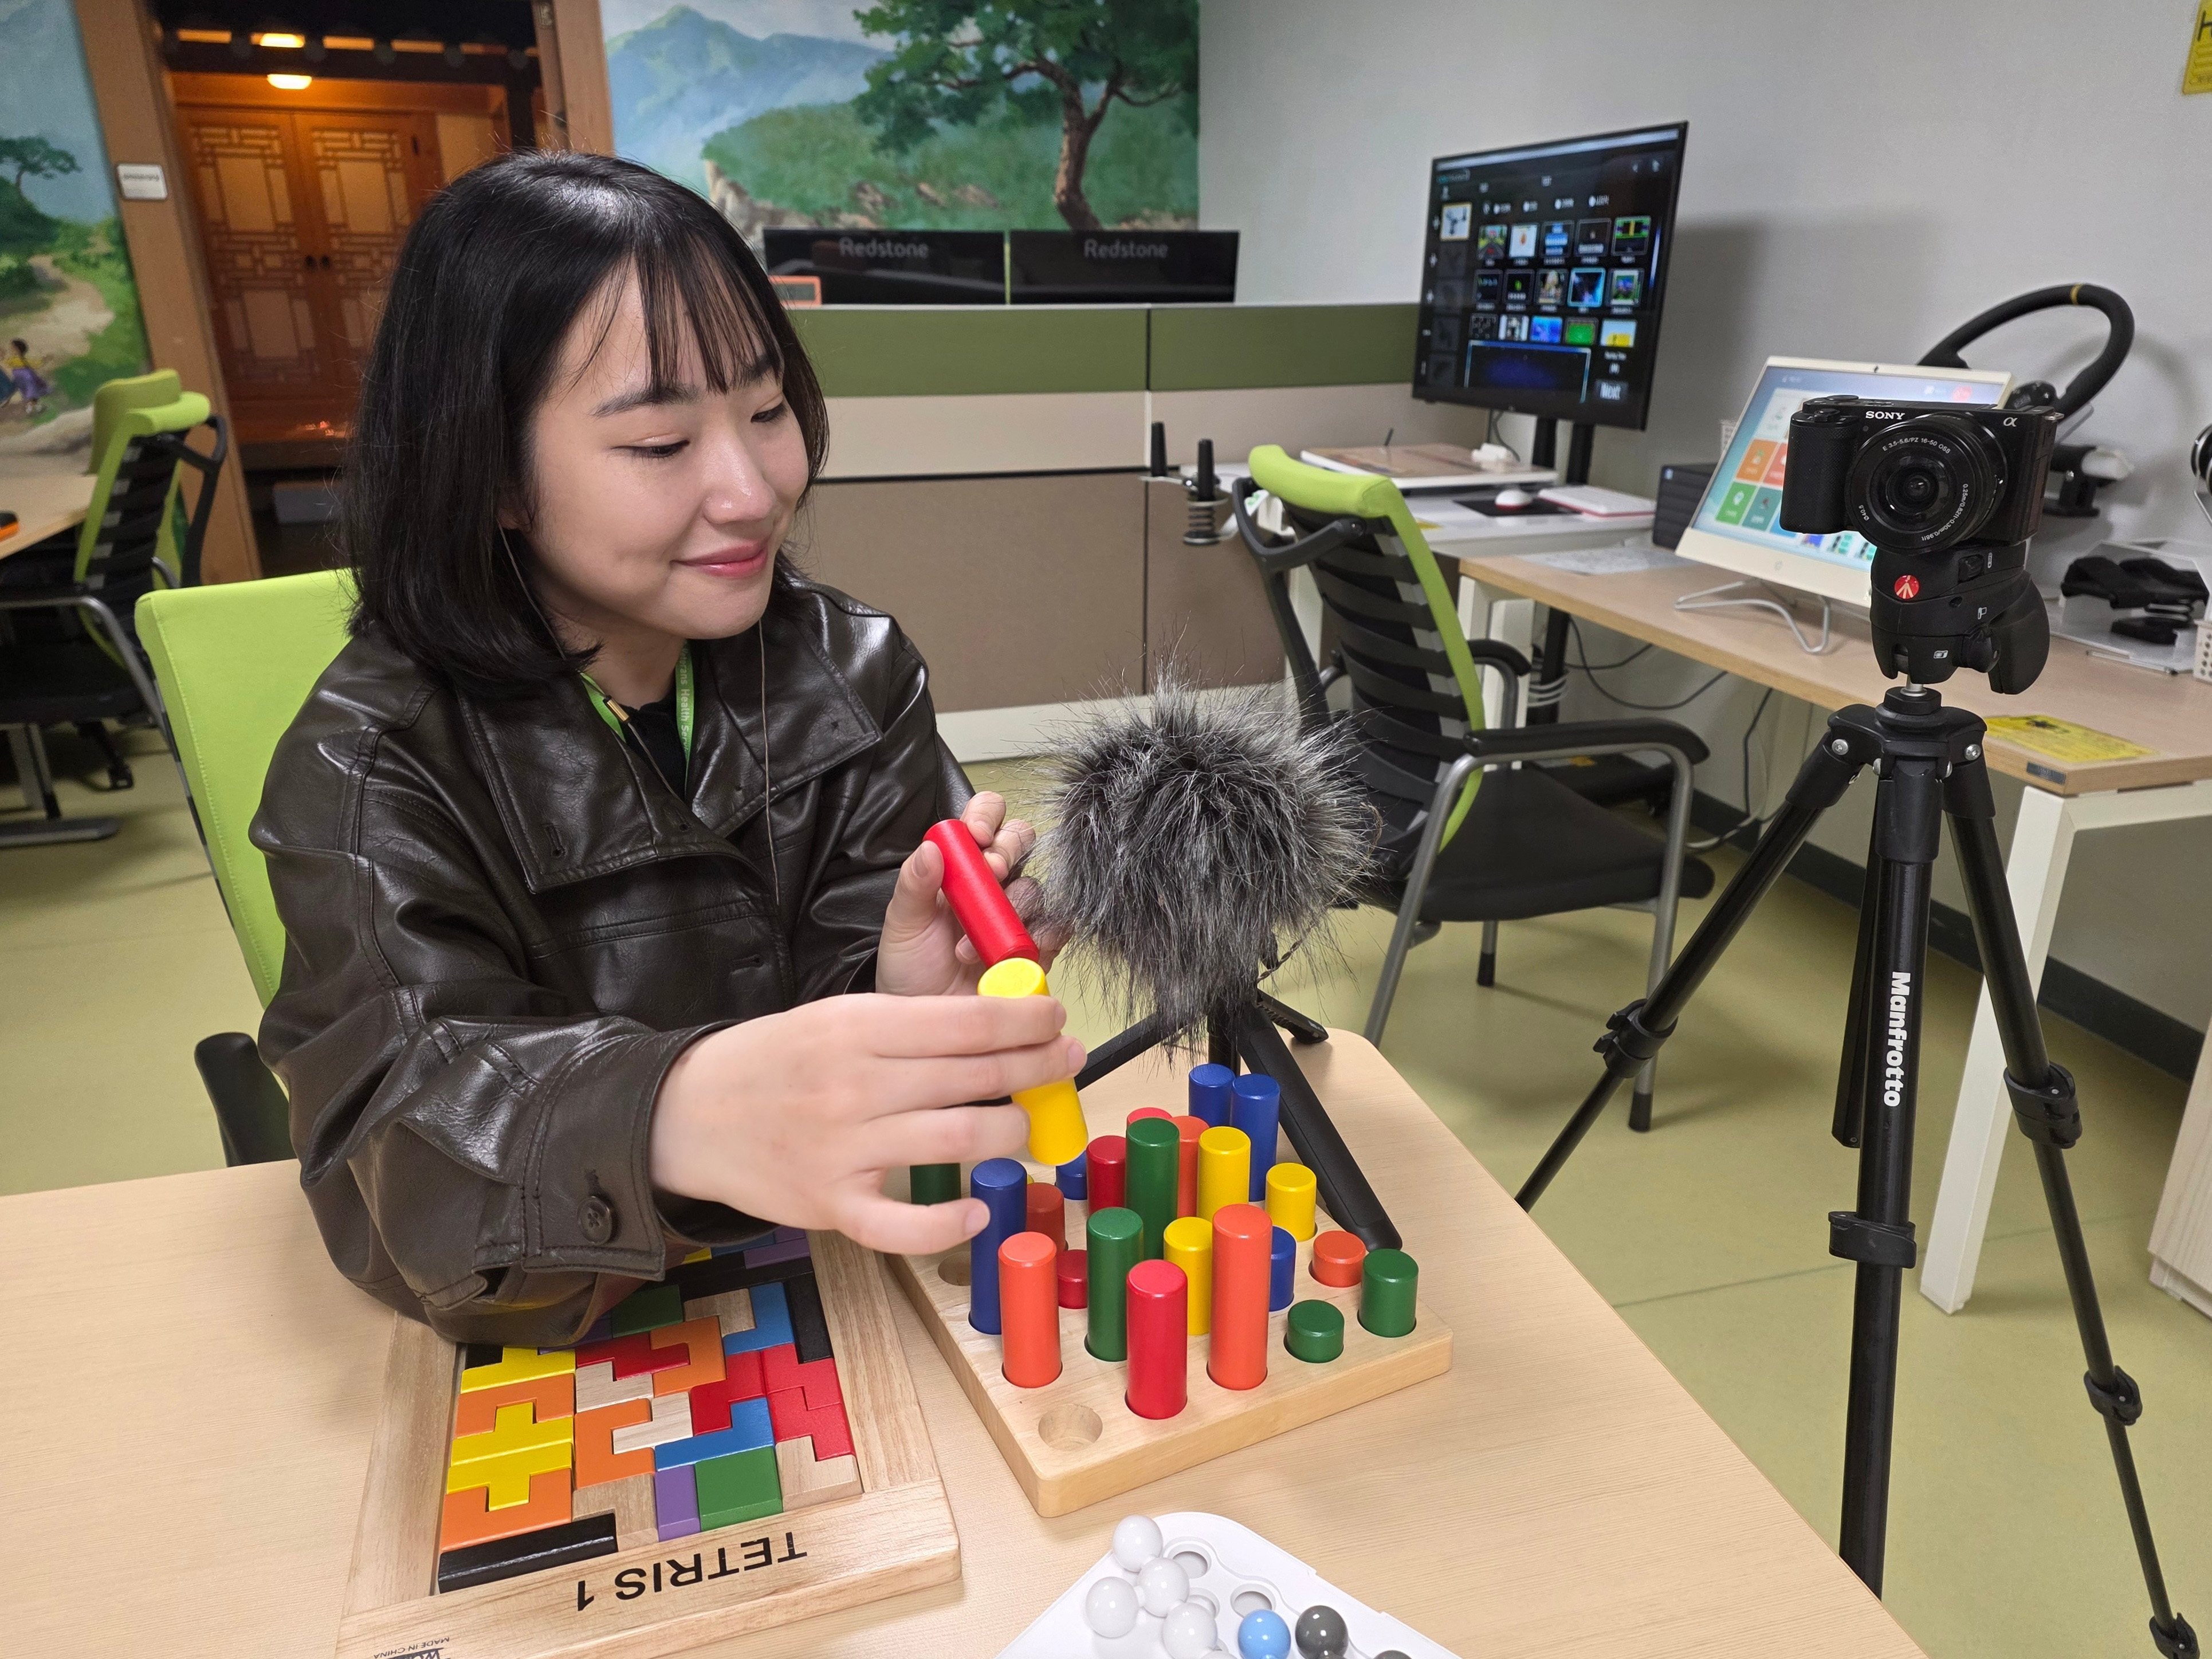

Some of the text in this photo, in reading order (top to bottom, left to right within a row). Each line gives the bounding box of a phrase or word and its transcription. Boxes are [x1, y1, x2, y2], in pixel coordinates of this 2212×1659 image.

[839, 237, 928, 258] Redstone
[1084, 239, 1168, 260] Redstone
[1865, 411, 1905, 420] SONY
[1888, 437, 1919, 449] 3.5-5.6/PZ
[1921, 438, 1938, 446] 16-50
[1938, 443, 1951, 454] OSS
[681, 688, 690, 721] Health
[1883, 972, 1911, 1107] Manfrotto
[577, 1532, 808, 1611] TETRIS 1
[374, 1648, 406, 1659] CHINA
[421, 1637, 450, 1649] MADE
